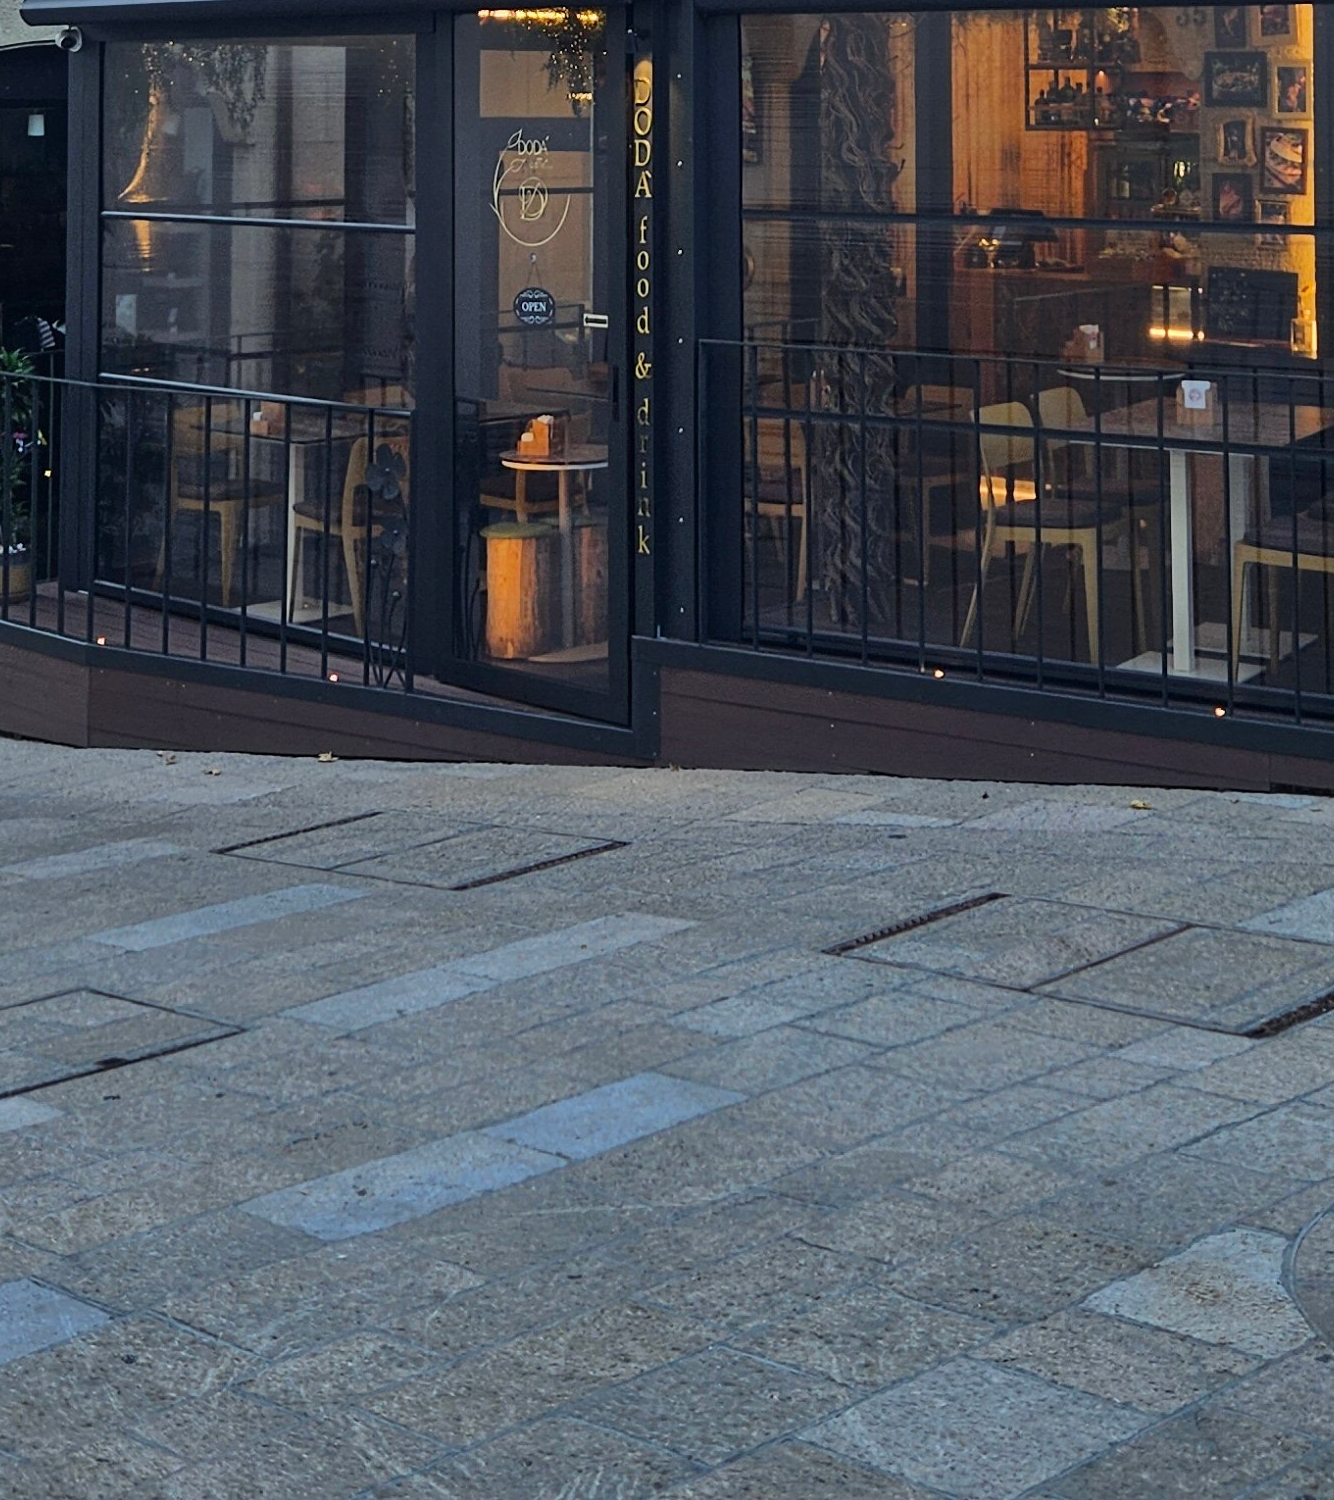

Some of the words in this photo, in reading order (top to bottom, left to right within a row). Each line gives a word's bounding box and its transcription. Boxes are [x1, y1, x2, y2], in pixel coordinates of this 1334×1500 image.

[521, 301, 547, 312] OPEN
[636, 215, 650, 334] food
[635, 351, 652, 380] &
[636, 397, 651, 555] drink
